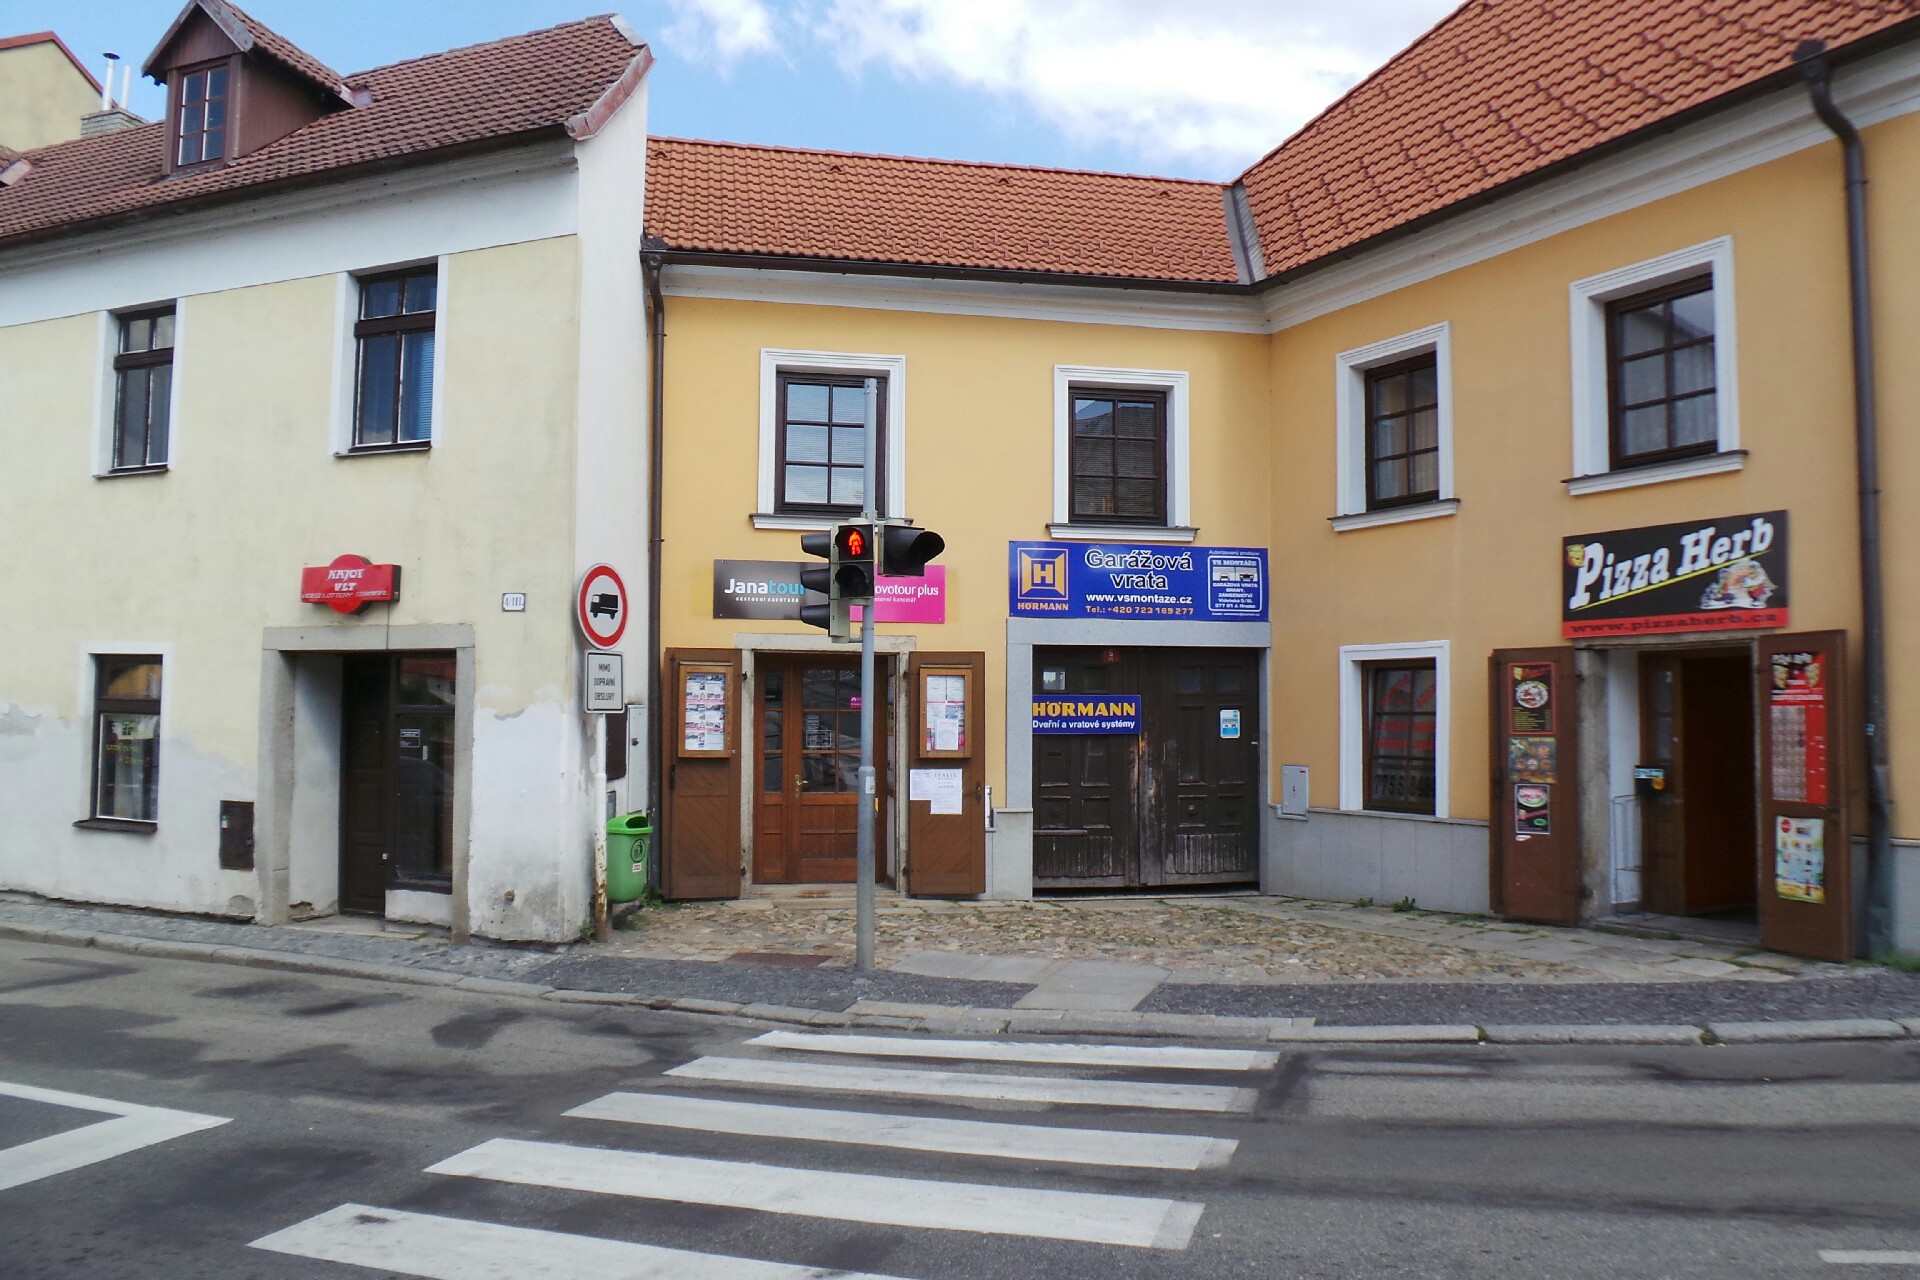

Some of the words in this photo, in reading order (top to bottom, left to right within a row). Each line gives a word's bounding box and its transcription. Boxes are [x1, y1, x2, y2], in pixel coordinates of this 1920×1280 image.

[1085, 549, 1193, 571] Garážová
[1569, 542, 1670, 609] Pizza
[1675, 517, 1774, 576] Herb
[327, 568, 365, 581] KAJOT
[1033, 563, 1054, 584] H
[334, 582, 357, 591] VLT
[1110, 571, 1169, 590] vrata
[874, 584, 917, 595] ovotour
[917, 583, 939, 599] plus
[1085, 593, 1193, 605] www.vsmontaze.cz
[1017, 602, 1069, 611] HÖRMANN
[1085, 605, 1106, 613] Tel.:
[1107, 606, 1132, 614] +420
[1134, 606, 1154, 614] 723
[1155, 607, 1174, 615] 169
[1175, 607, 1194, 615] 277
[1571, 613, 1777, 632] www.pizzaherb.cz
[598, 663, 611, 672] MIMO
[594, 676, 615, 686] DOPRAVNÍ
[594, 692, 615, 701] OBSLUHY
[1032, 701, 1136, 717] HÖRMANN
[1032, 719, 1060, 728] Dveřní
[1068, 719, 1100, 728] vratové
[1101, 720, 1136, 730] systémy
